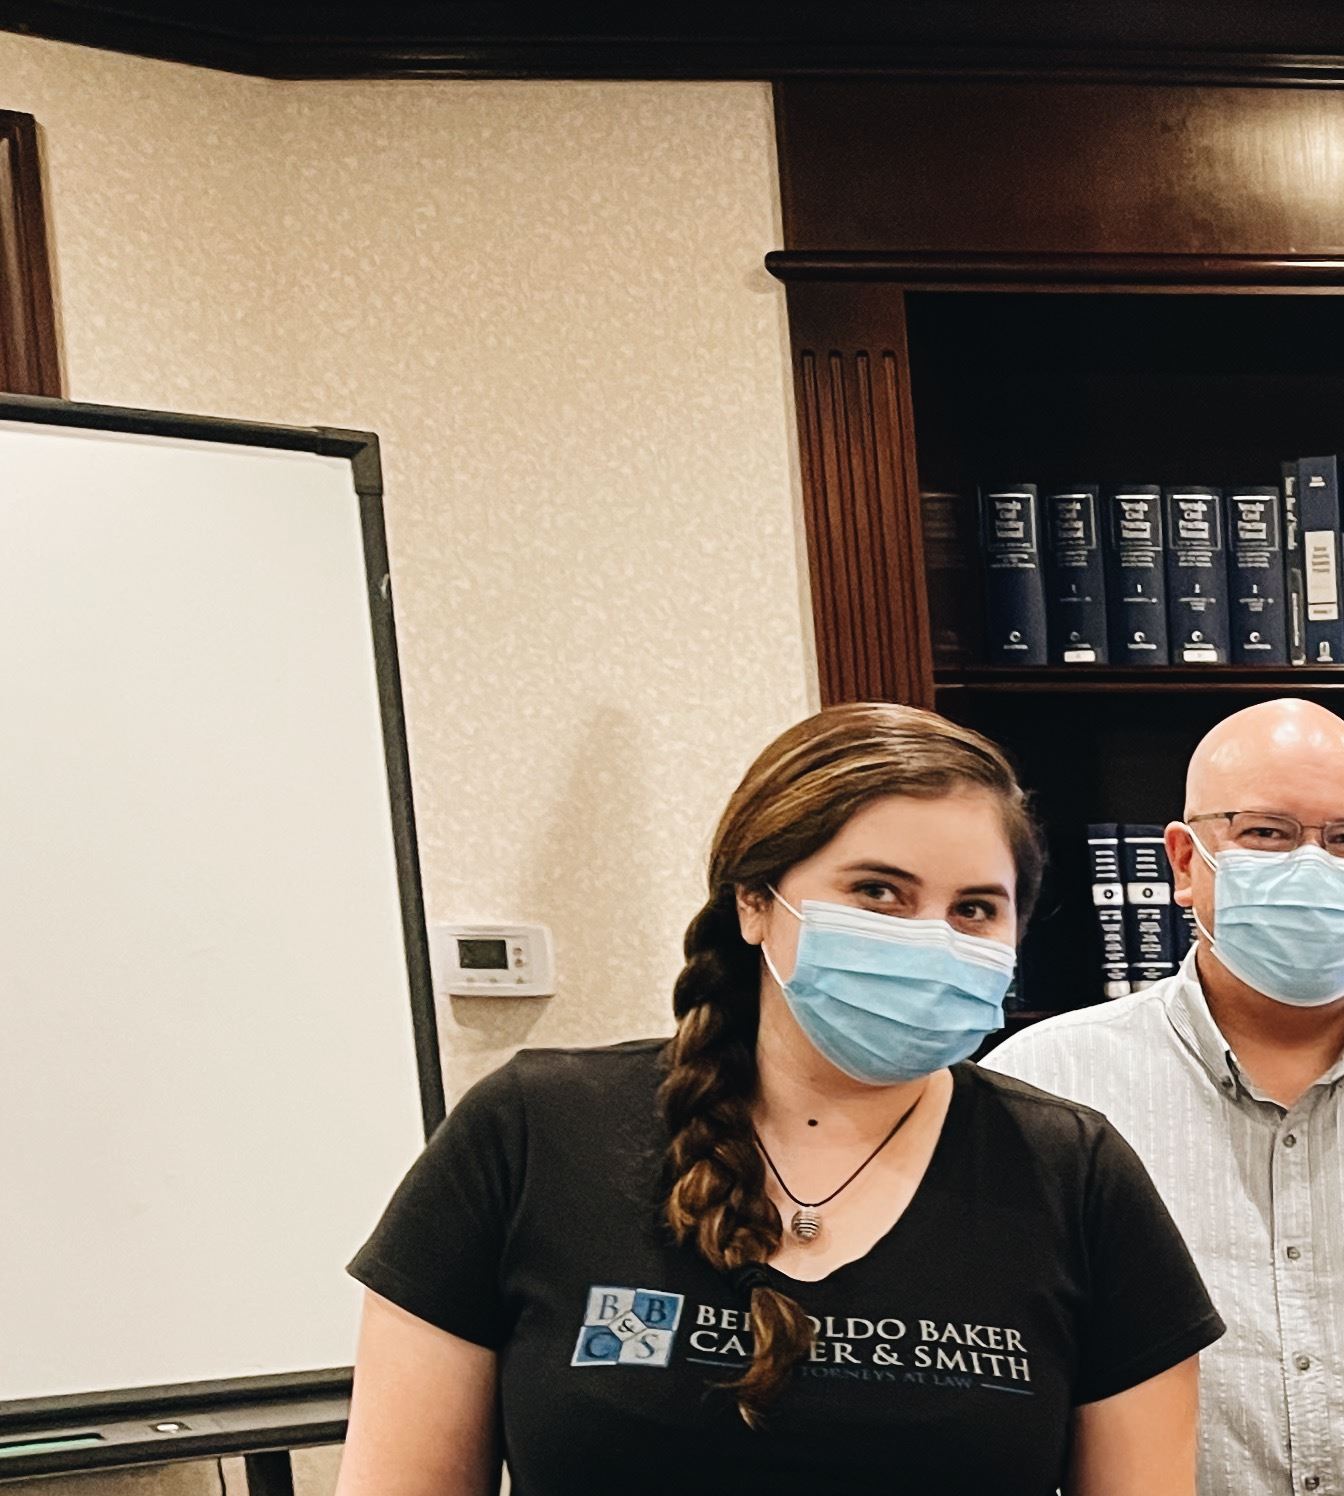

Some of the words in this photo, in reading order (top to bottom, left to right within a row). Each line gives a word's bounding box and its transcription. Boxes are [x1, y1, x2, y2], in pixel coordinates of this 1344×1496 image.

[647, 1299, 667, 1325] B
[921, 1320, 1029, 1353] BAKER
[689, 1329, 862, 1365] CAER
[872, 1342, 904, 1366] &
[914, 1345, 1032, 1382] SMITH
